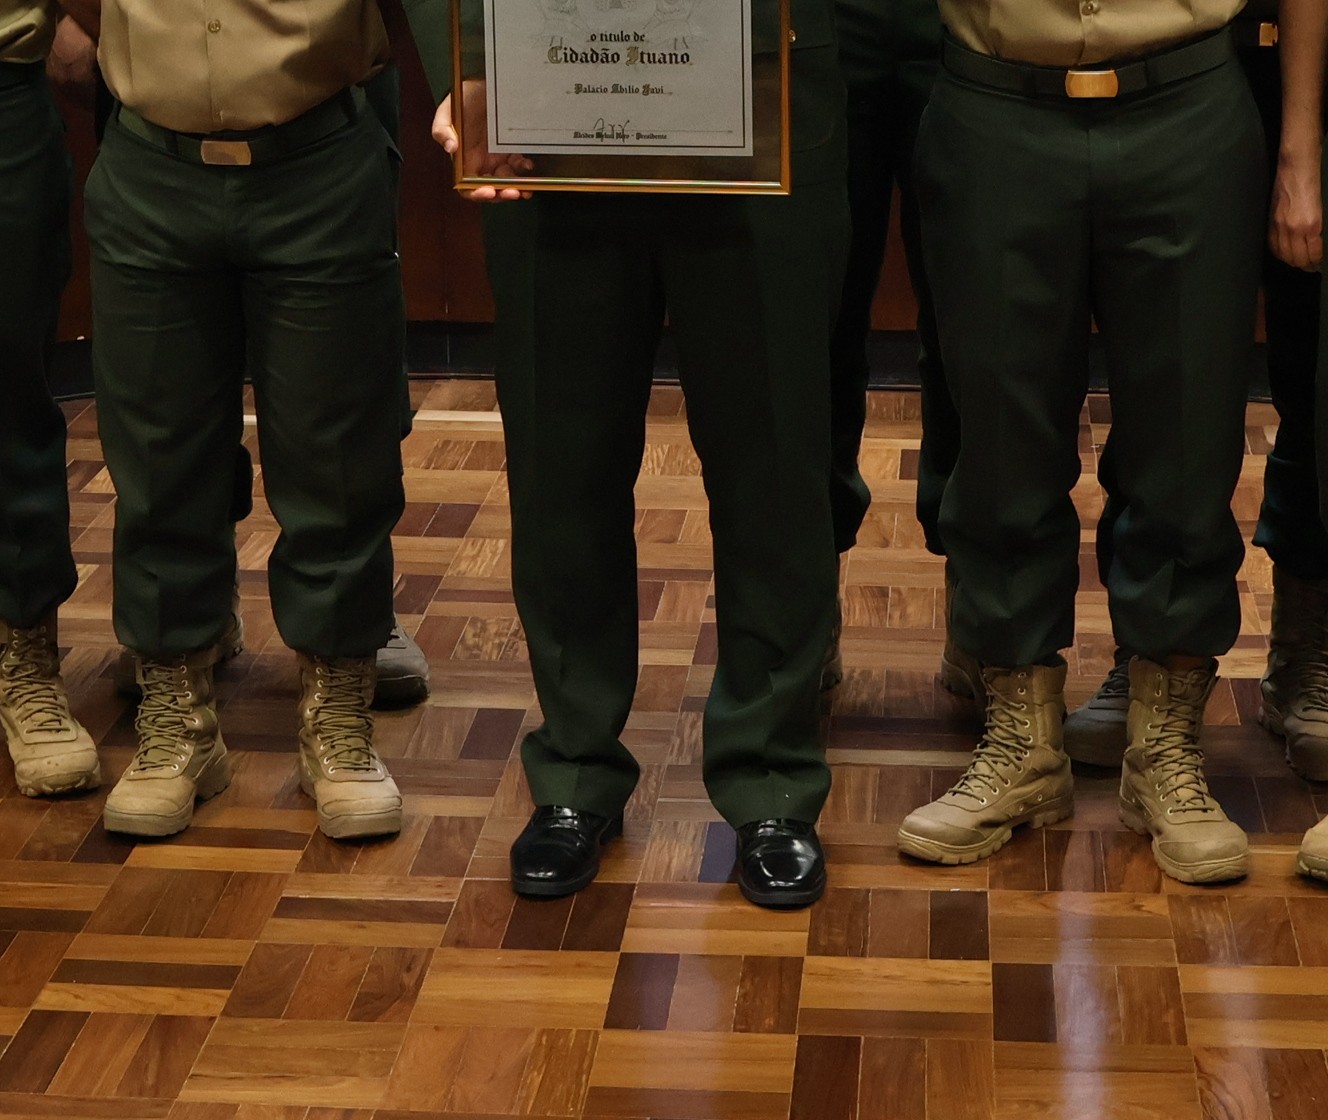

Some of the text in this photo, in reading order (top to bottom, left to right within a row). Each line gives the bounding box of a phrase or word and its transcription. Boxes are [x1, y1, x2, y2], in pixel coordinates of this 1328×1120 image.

[590, 33, 597, 43] o
[633, 31, 646, 43] de
[547, 45, 690, 67] Cidadão Ituano
[635, 132, 668, 141] Presidente
